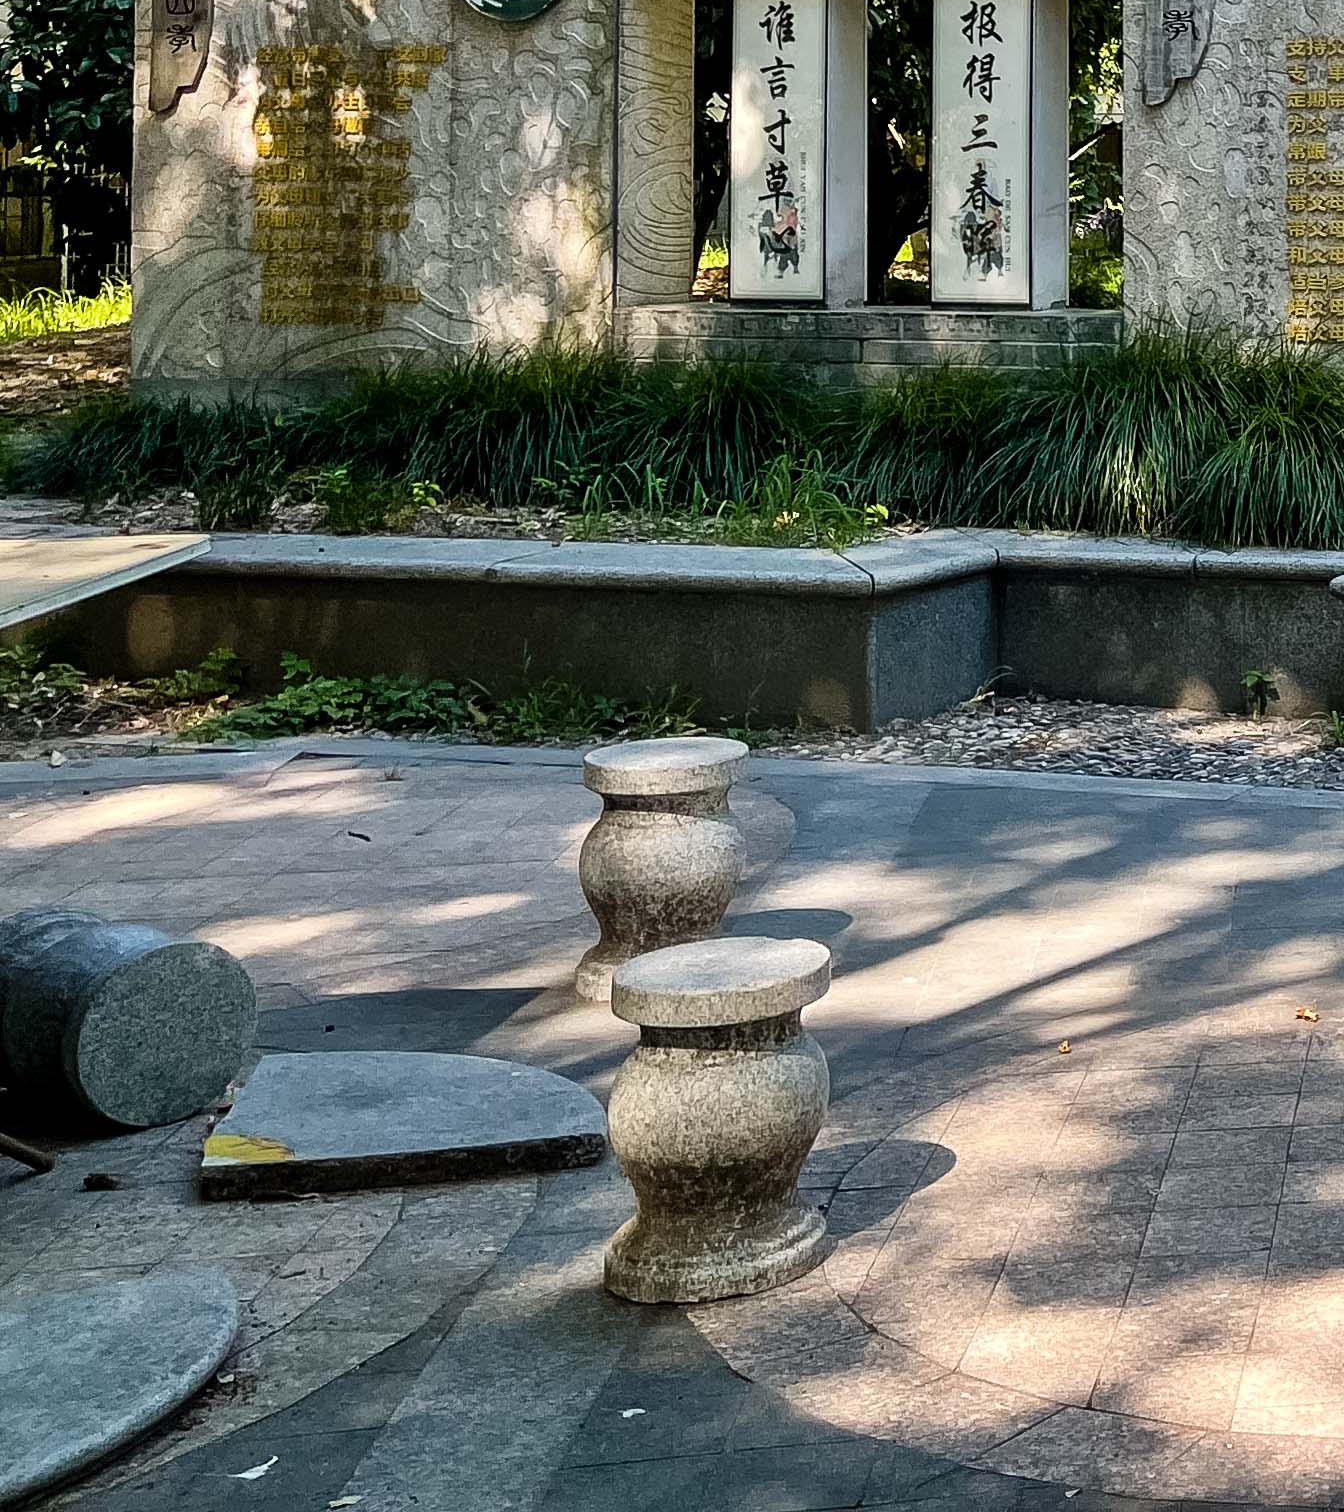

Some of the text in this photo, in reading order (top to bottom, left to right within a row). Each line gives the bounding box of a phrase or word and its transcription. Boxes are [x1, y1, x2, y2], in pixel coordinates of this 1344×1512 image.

[759, 0, 798, 253] 谁言寸草心
[960, 0, 1004, 258] 报得三春晖
